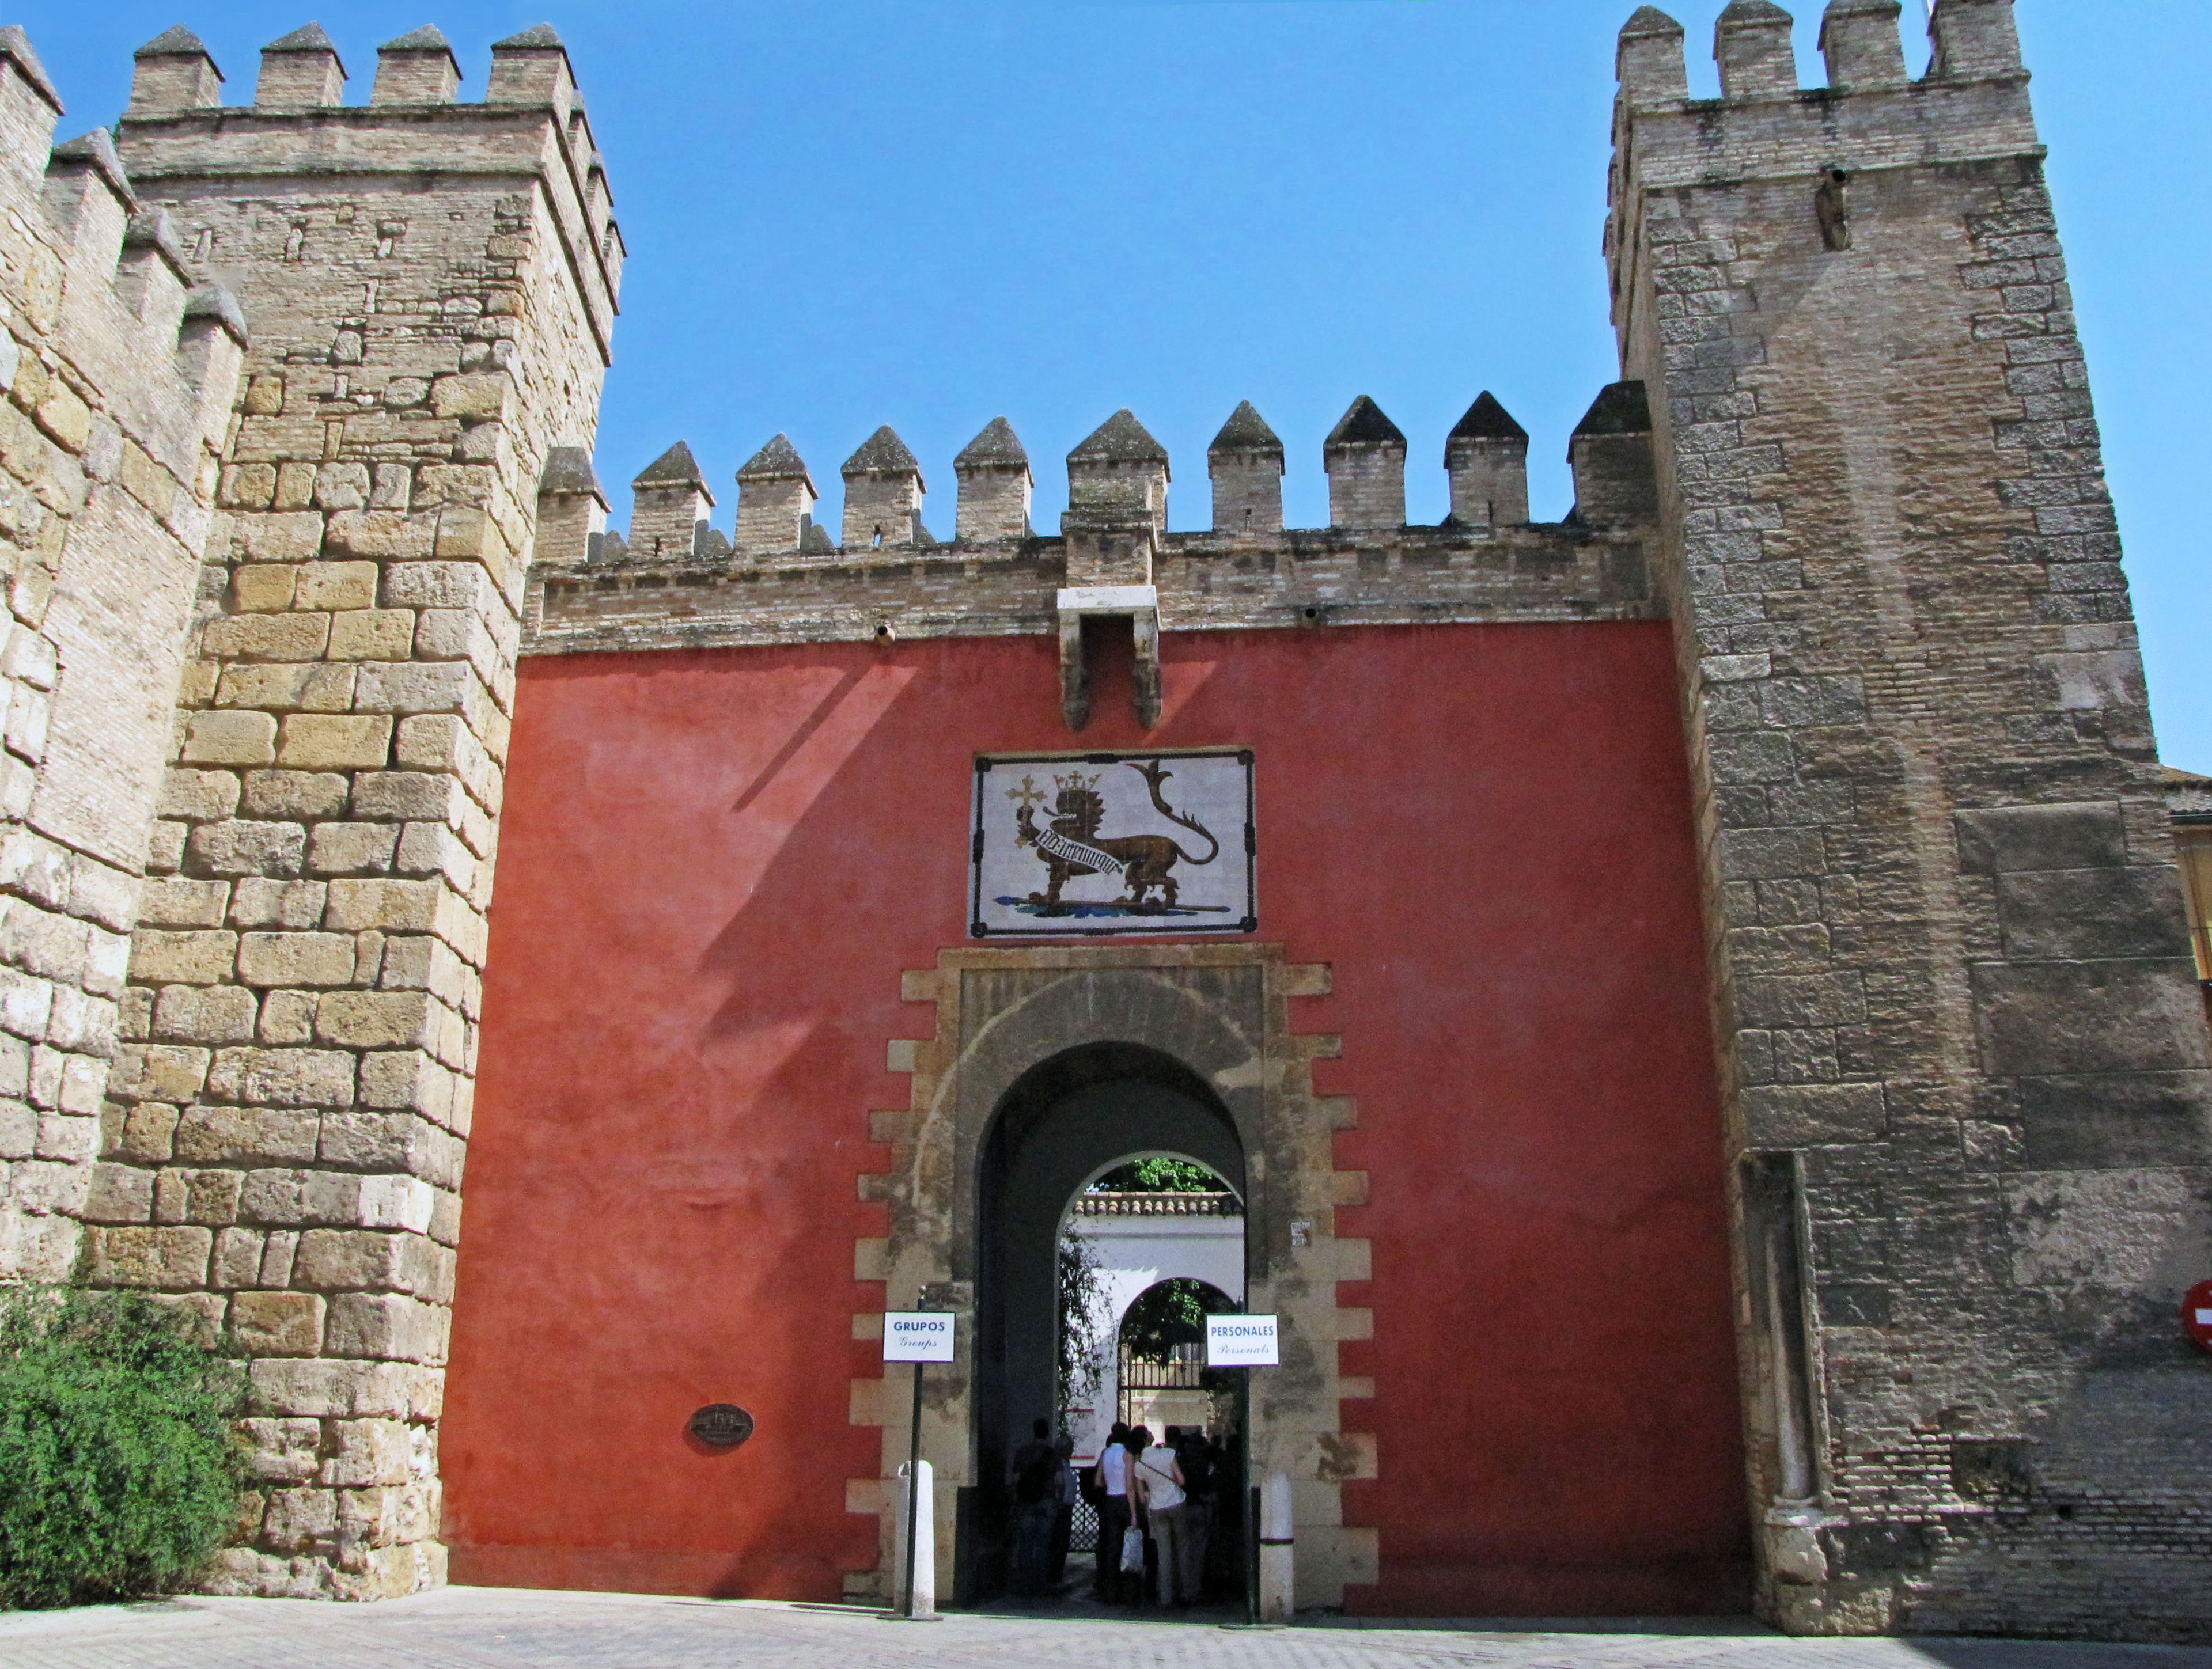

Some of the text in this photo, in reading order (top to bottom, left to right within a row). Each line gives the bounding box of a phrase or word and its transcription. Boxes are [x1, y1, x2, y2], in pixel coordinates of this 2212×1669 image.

[893, 1321, 945, 1332] GRUPOS
[1211, 1326, 1273, 1336] PERSONALES
[900, 1337, 937, 1349] Groups
[1217, 1344, 1269, 1353] Personals
